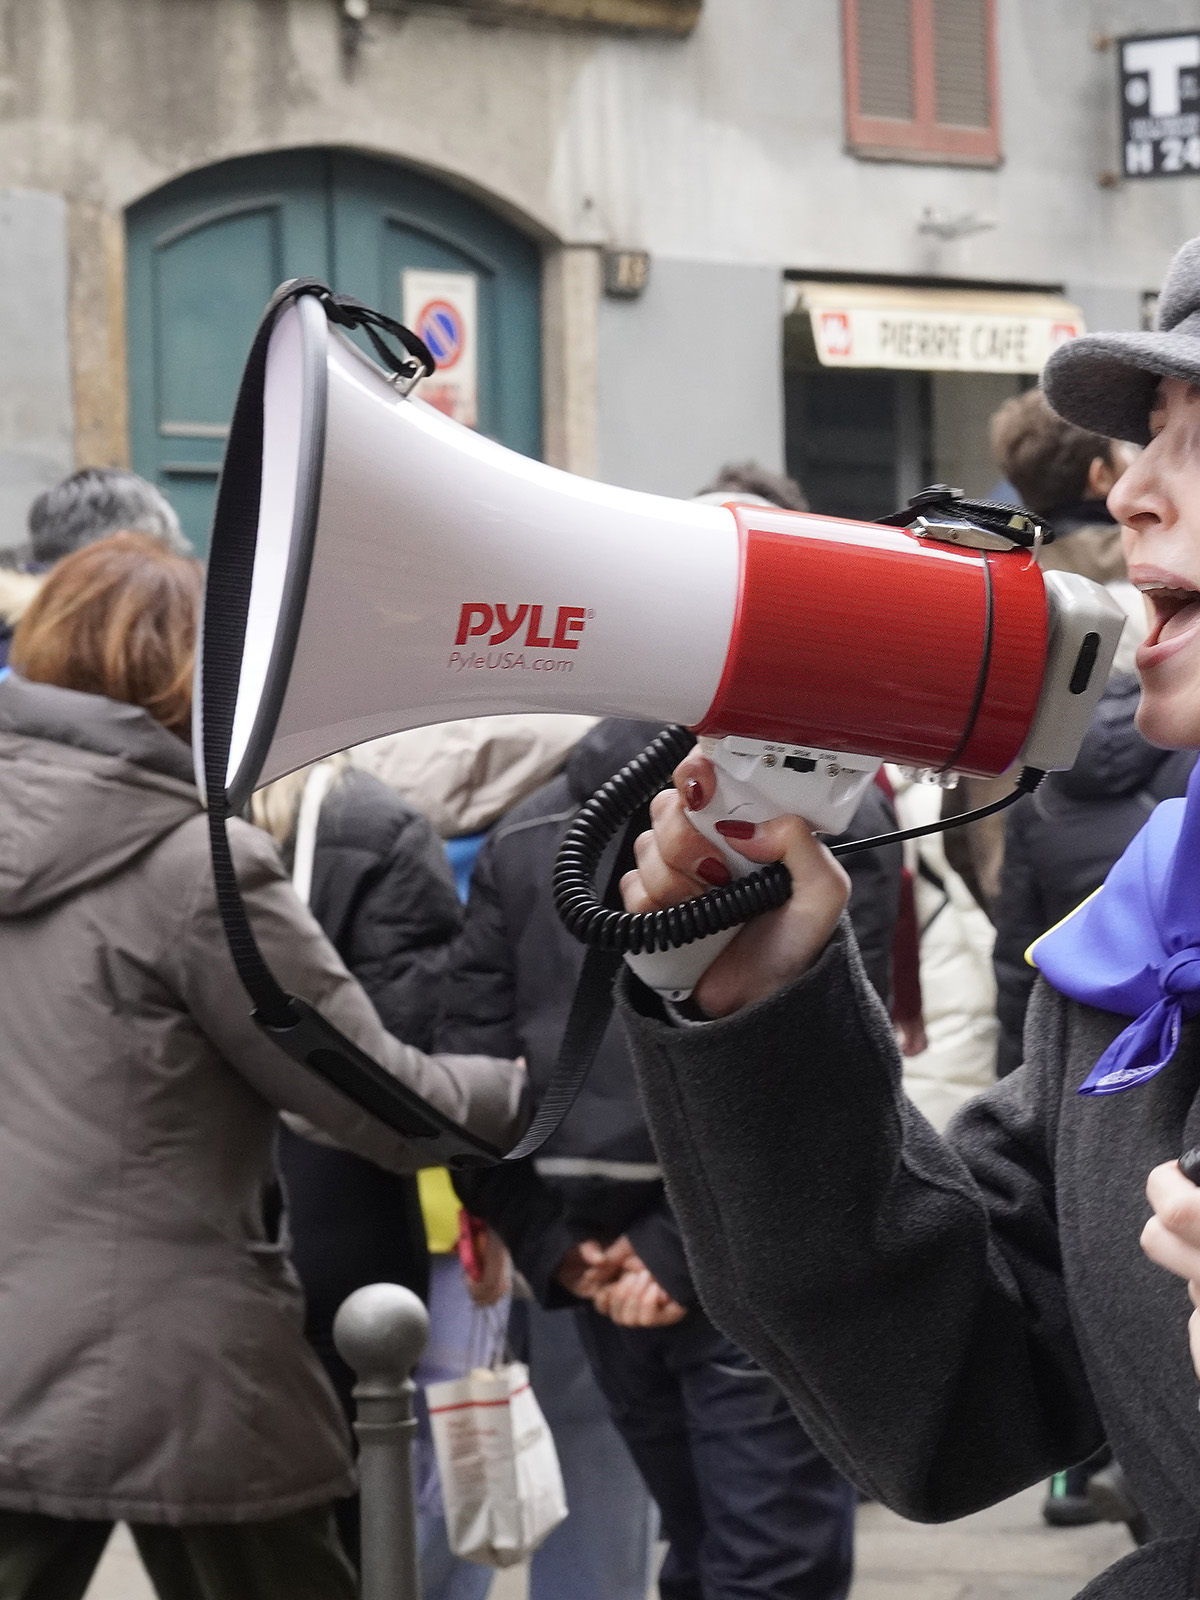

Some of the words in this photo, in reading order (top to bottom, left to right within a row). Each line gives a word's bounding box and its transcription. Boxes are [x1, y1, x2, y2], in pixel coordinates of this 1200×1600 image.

[1126, 142, 1153, 174] H
[880, 320, 960, 358] PIERRE
[454, 602, 586, 649] PYLE
[447, 651, 574, 673] PyleUSA.com
